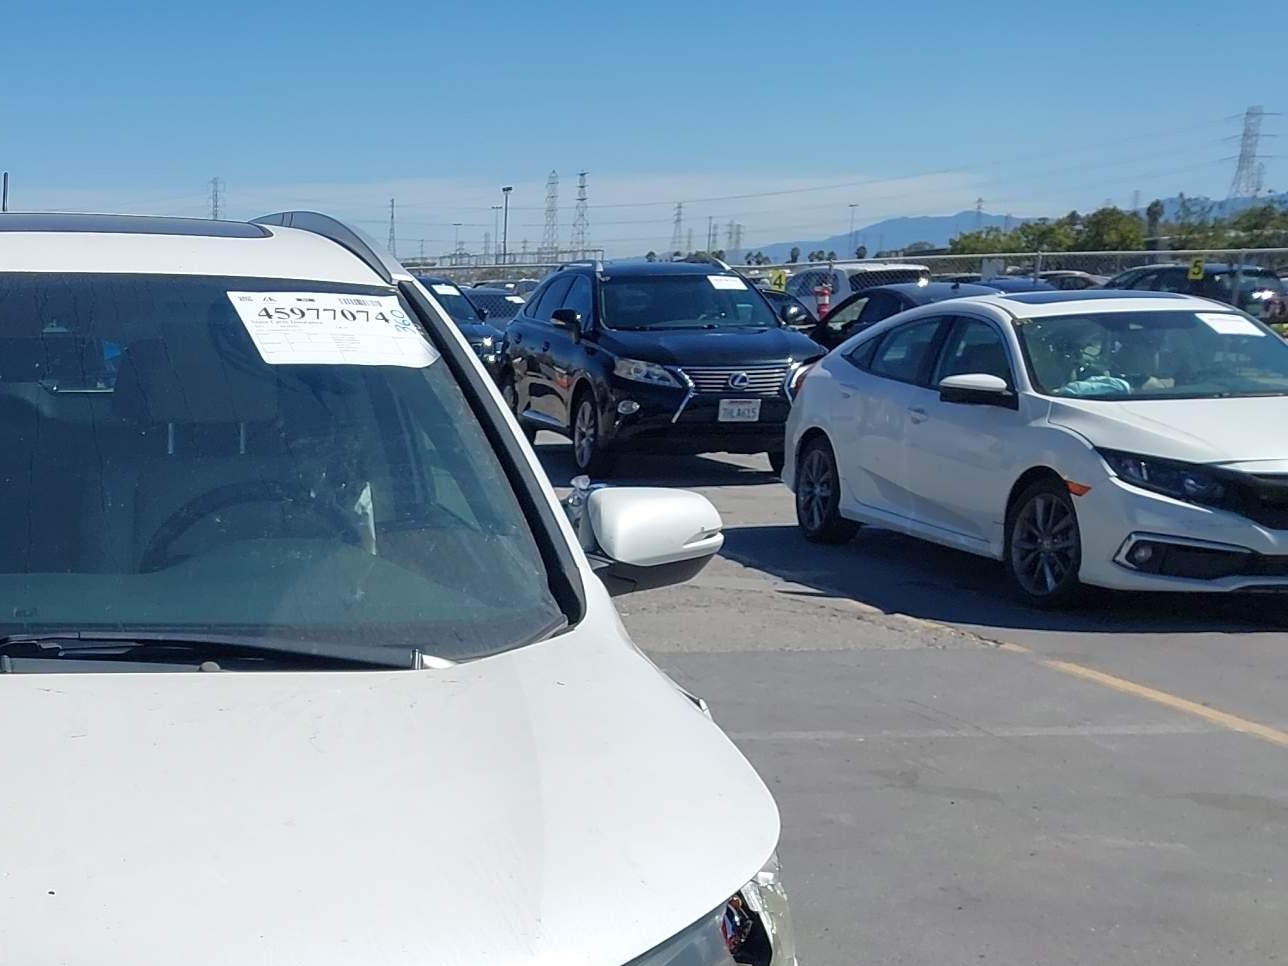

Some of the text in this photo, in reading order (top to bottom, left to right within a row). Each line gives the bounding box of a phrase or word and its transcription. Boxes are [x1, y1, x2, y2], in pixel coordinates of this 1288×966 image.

[1192, 259, 1202, 275] 5
[773, 273, 783, 289] 4
[258, 307, 390, 323] 45977074
